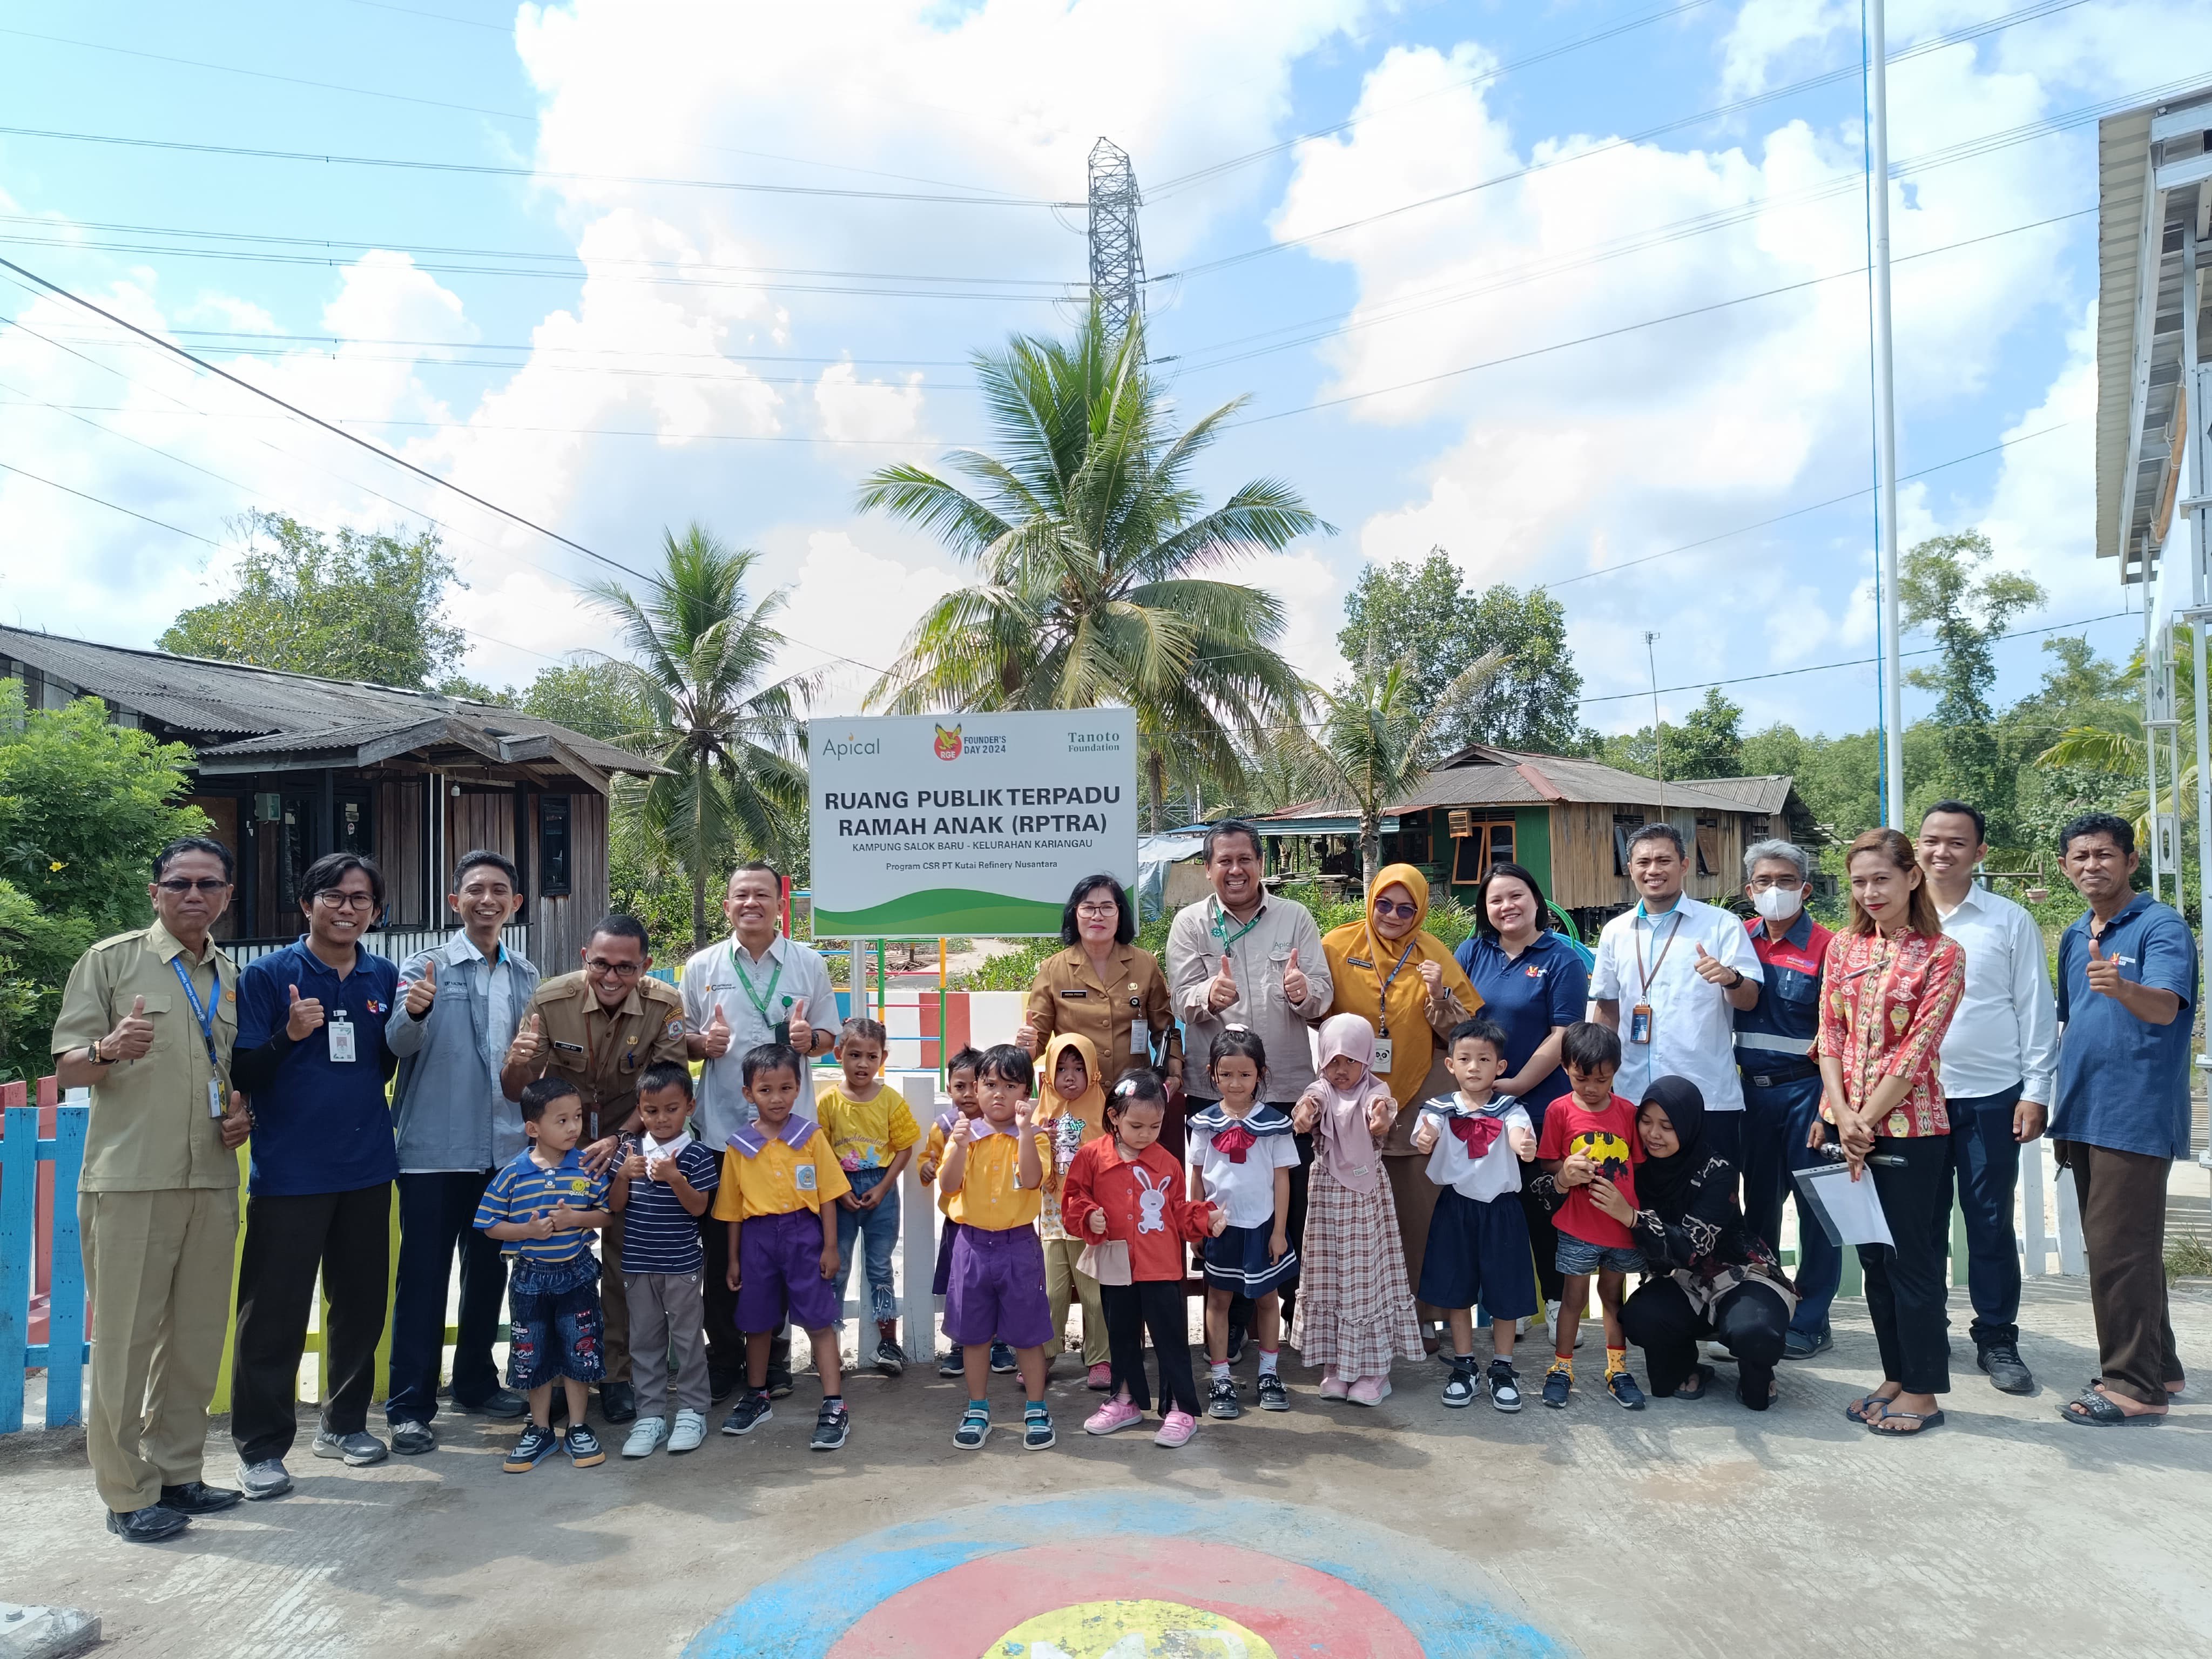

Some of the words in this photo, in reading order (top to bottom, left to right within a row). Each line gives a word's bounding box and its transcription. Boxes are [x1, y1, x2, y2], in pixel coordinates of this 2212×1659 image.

[964, 736, 1007, 744] FOUNDER'S
[1068, 732, 1120, 743] Tanoto
[822, 735, 880, 760] Apical
[964, 745, 981, 754] DAY
[982, 745, 1006, 753] 2024
[1068, 743, 1120, 752] Foundation
[825, 791, 908, 810] RUANG
[918, 790, 1003, 808] PUBLIK
[1007, 786, 1120, 806] TERPADU
[839, 818, 926, 837] RAMAH
[933, 817, 1004, 834] ANAK
[1012, 813, 1107, 835] (RPTRA)
[853, 842, 901, 852] KAMPUNG
[903, 842, 935, 851] SALOK
[938, 841, 964, 850] BARU
[973, 840, 1031, 849] KELURAHAN
[1034, 839, 1092, 848] KARIANGAU
[886, 862, 921, 872] Program
[942, 861, 953, 869] PT
[979, 861, 1013, 870] Refinery
